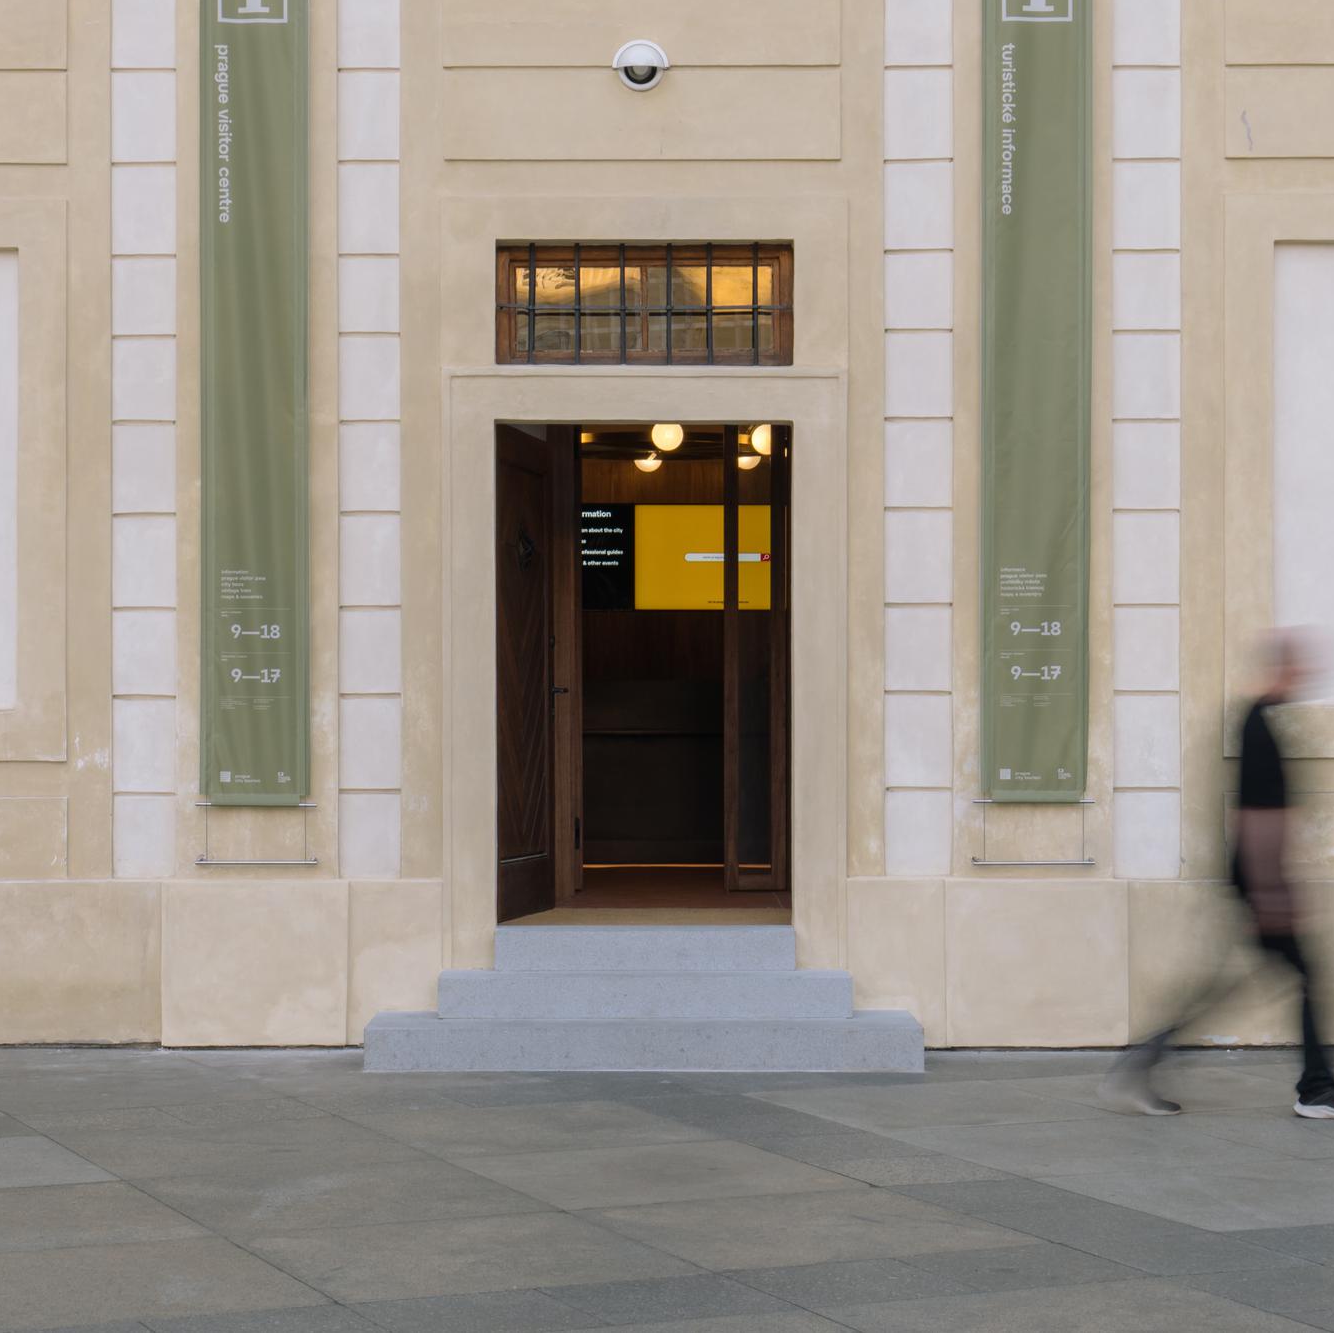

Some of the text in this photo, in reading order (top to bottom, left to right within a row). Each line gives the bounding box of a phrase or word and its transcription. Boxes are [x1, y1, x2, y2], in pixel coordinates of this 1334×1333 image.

[214, 44, 233, 223] prague visitor centre
[1001, 42, 1017, 215] turistické informace
